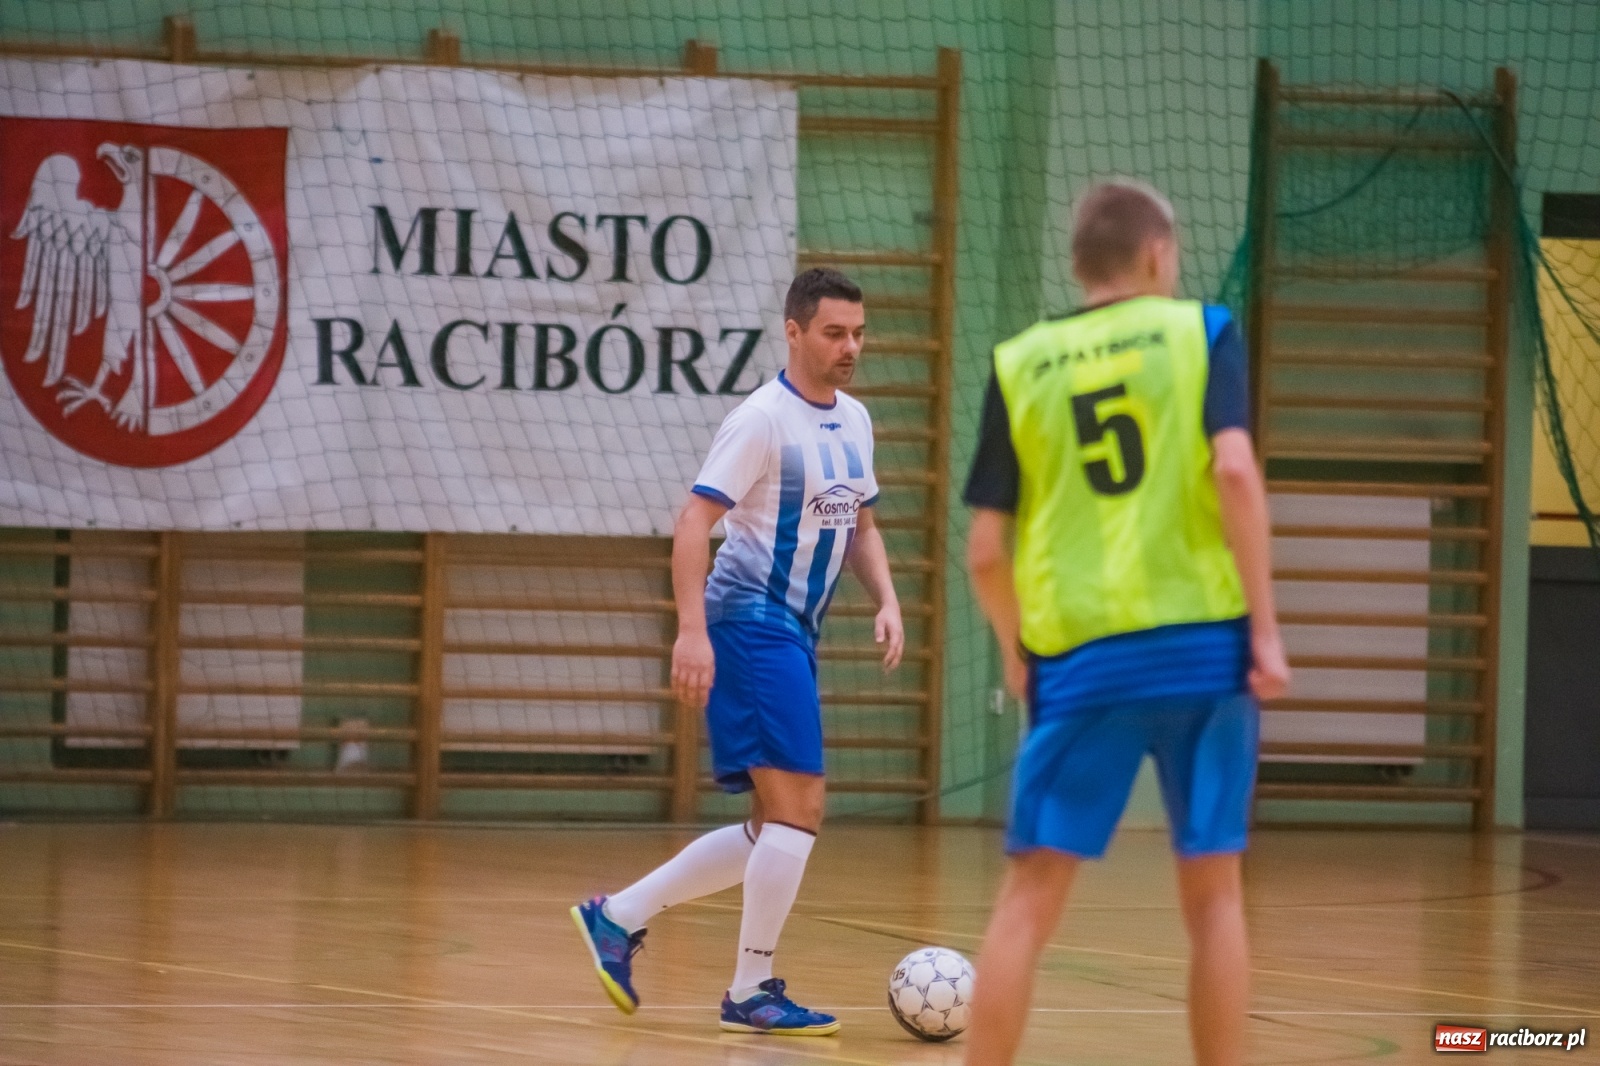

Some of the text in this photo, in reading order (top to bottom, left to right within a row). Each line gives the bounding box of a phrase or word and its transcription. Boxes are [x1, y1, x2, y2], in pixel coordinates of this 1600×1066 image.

[369, 205, 713, 285] MIASTO
[311, 303, 764, 395] RACIBÓRZ
[1071, 383, 1145, 496] 5
